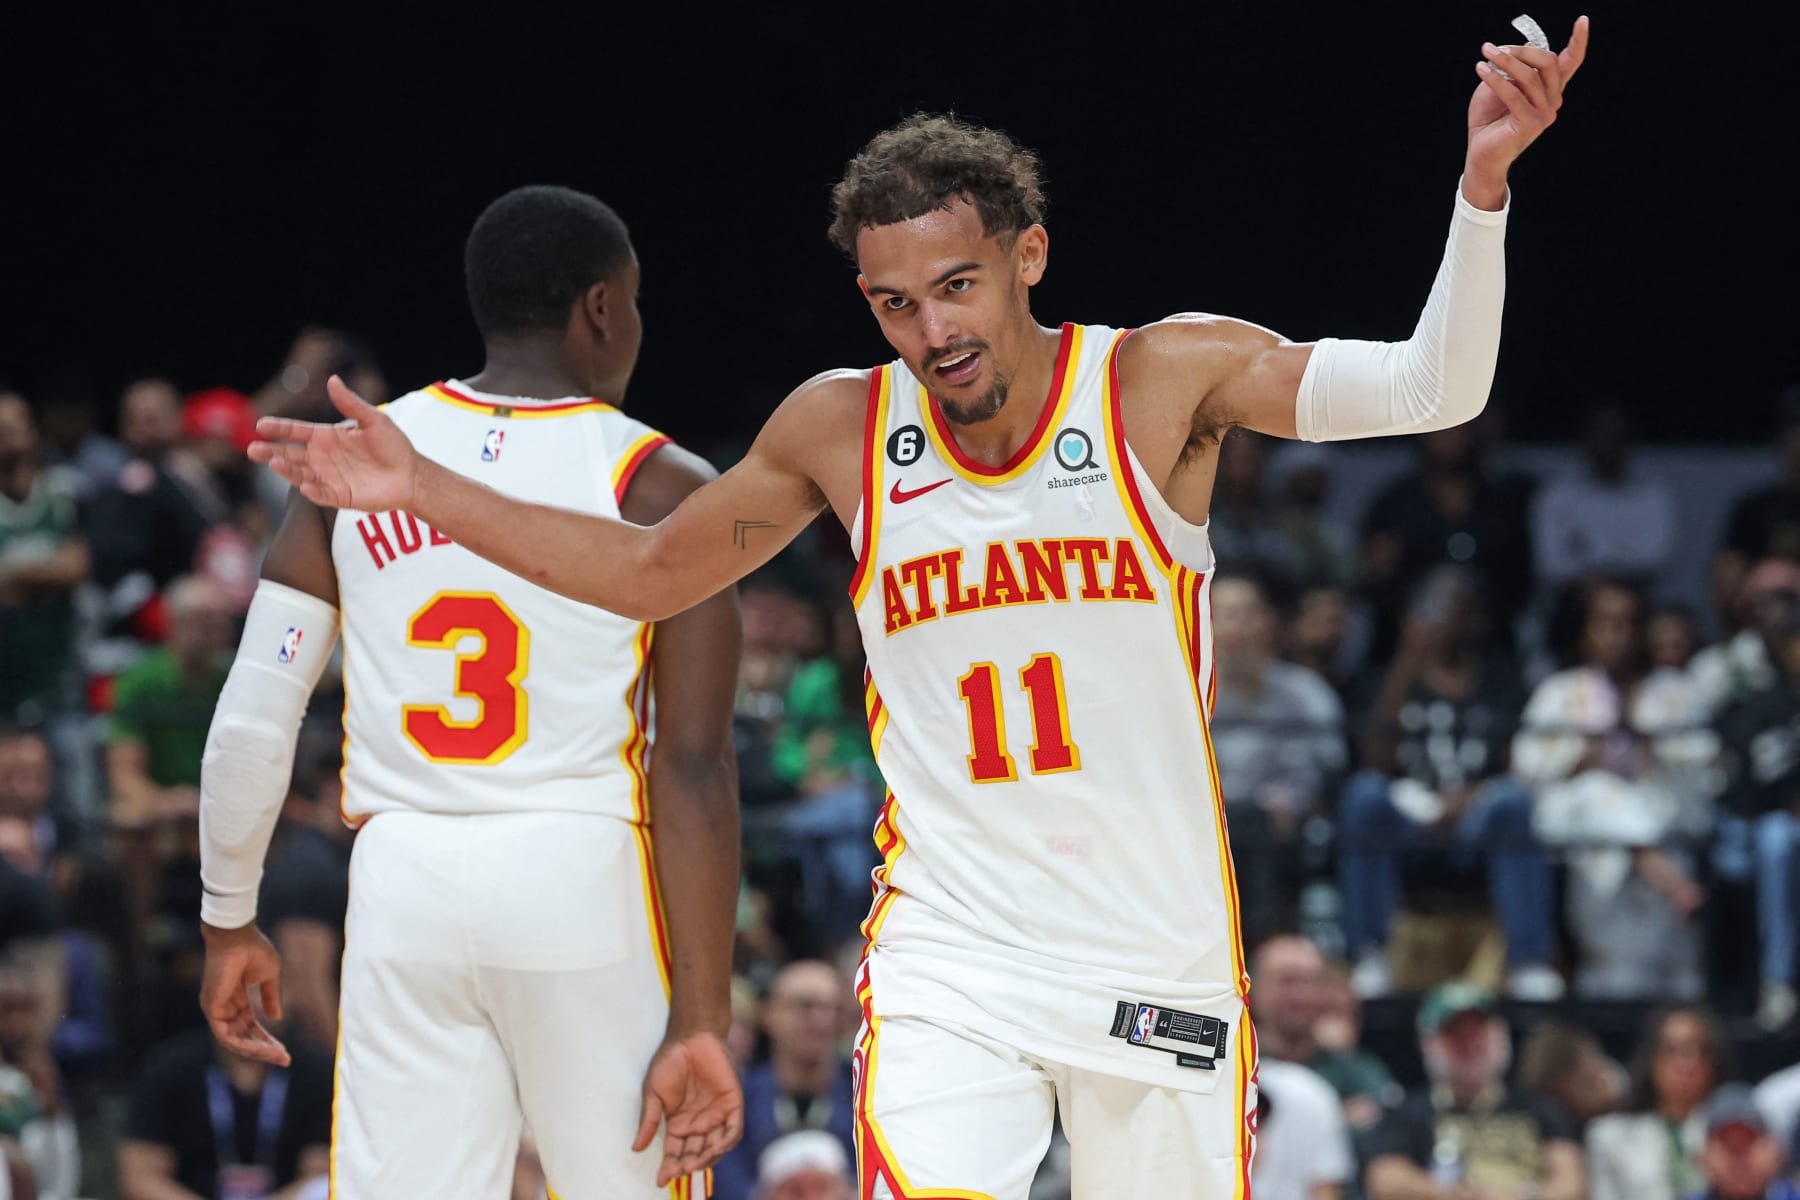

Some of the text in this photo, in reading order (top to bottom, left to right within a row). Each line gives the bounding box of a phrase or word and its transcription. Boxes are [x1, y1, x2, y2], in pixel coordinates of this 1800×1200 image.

[898, 432, 916, 462] 6
[1048, 472, 1108, 490] sharecare
[882, 538, 1157, 637] ATLANTA
[401, 590, 530, 766] 3
[958, 652, 1082, 784] 11
